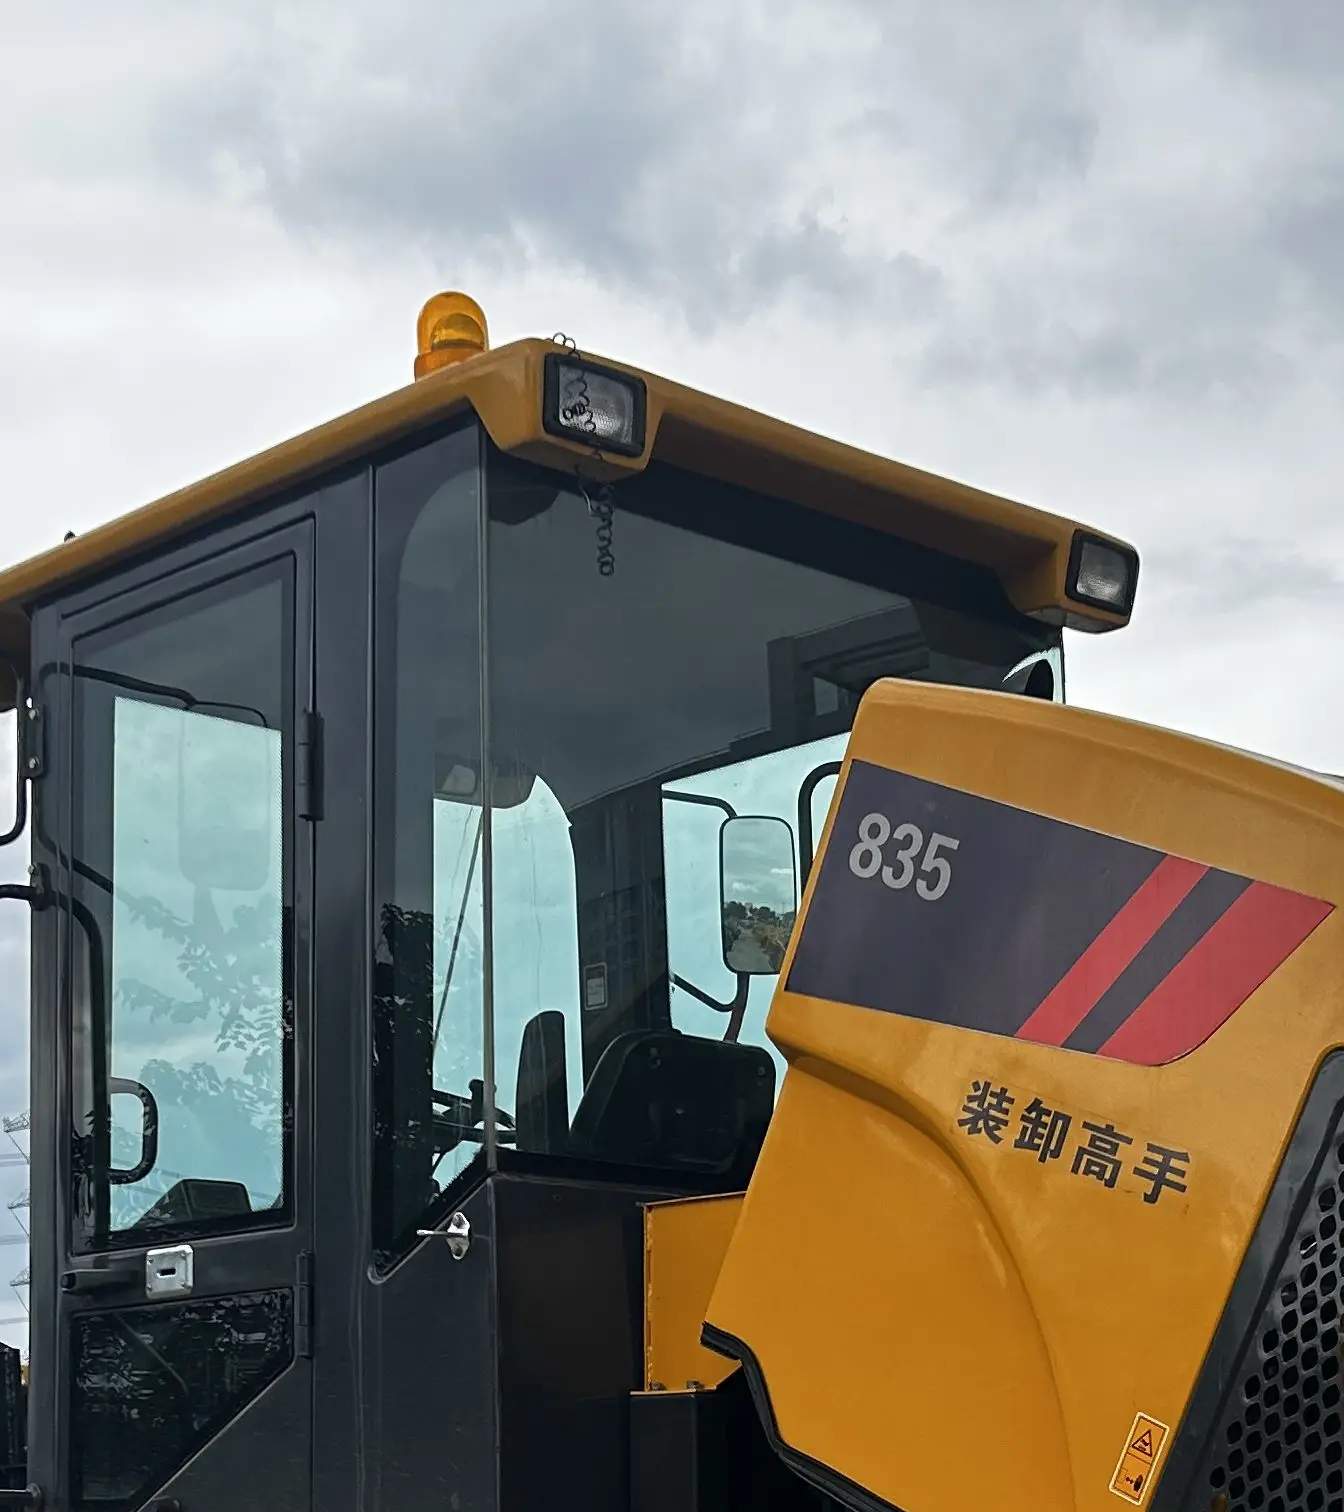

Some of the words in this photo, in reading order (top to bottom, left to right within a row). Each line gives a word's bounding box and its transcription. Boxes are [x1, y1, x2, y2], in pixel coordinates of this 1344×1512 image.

[848, 811, 960, 902] 835
[956, 1078, 1193, 1206] 装卸高手
